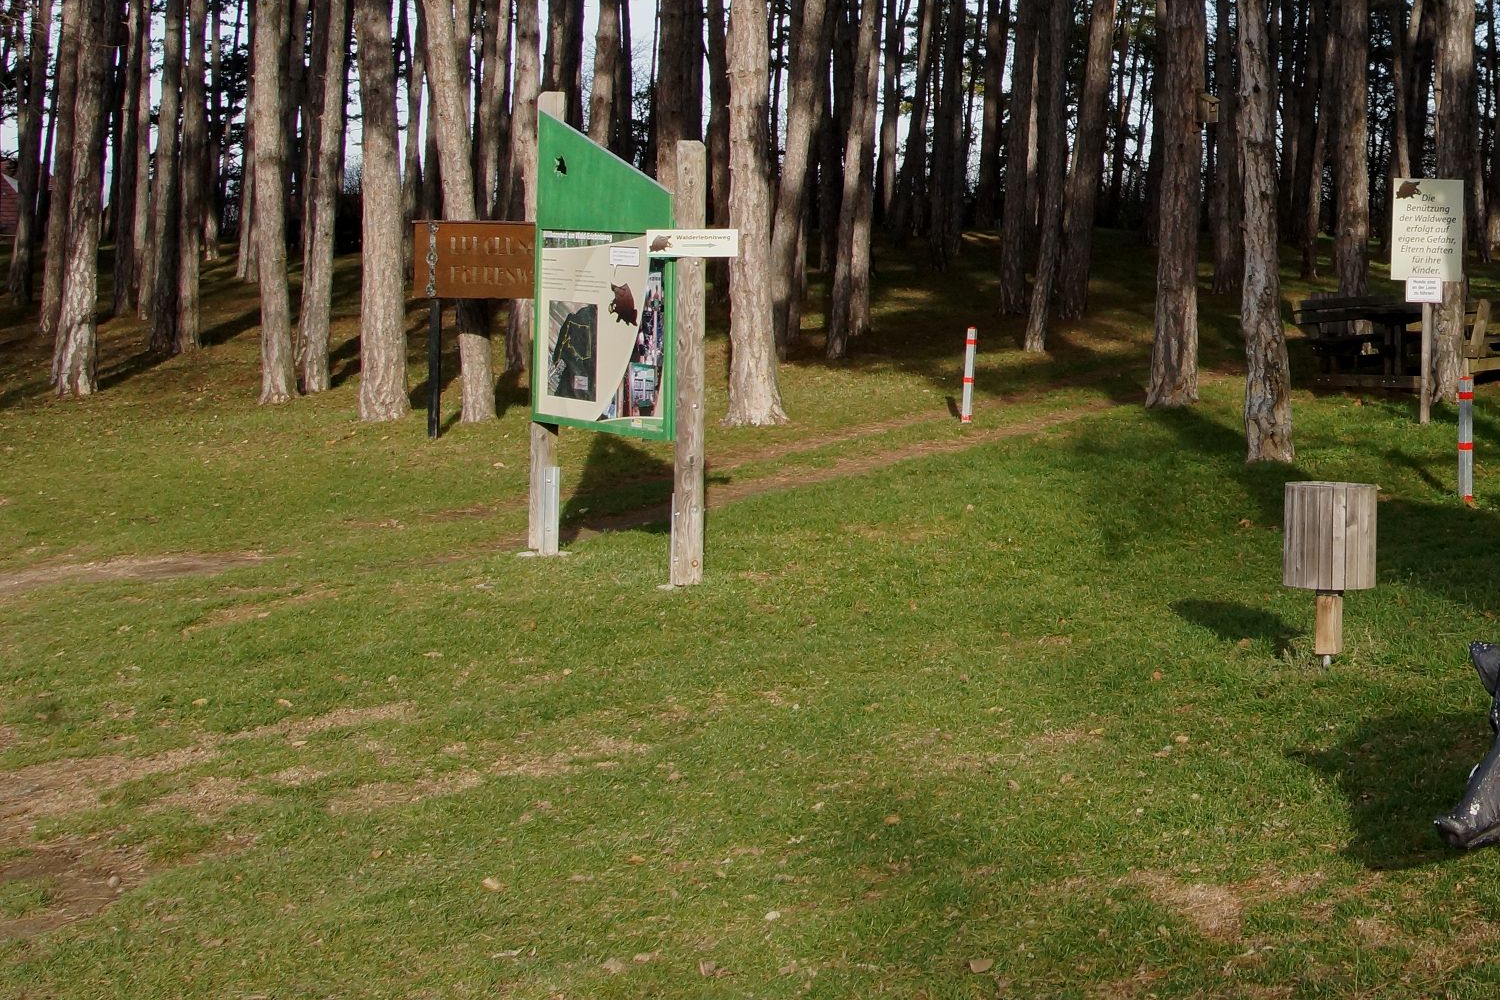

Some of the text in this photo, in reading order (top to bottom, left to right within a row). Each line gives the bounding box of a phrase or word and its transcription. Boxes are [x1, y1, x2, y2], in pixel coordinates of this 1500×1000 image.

[1421, 194, 1436, 203] Die
[1406, 203, 1450, 214] Benützung
[1399, 214, 1457, 226] der Waldwege
[1406, 224, 1451, 235] erfolgt auf
[1398, 235, 1457, 246] eigene Gefahr,
[1400, 244, 1454, 255] Eltern haften
[1411, 255, 1442, 265] für ihre
[1411, 266, 1441, 275] Kinder.
